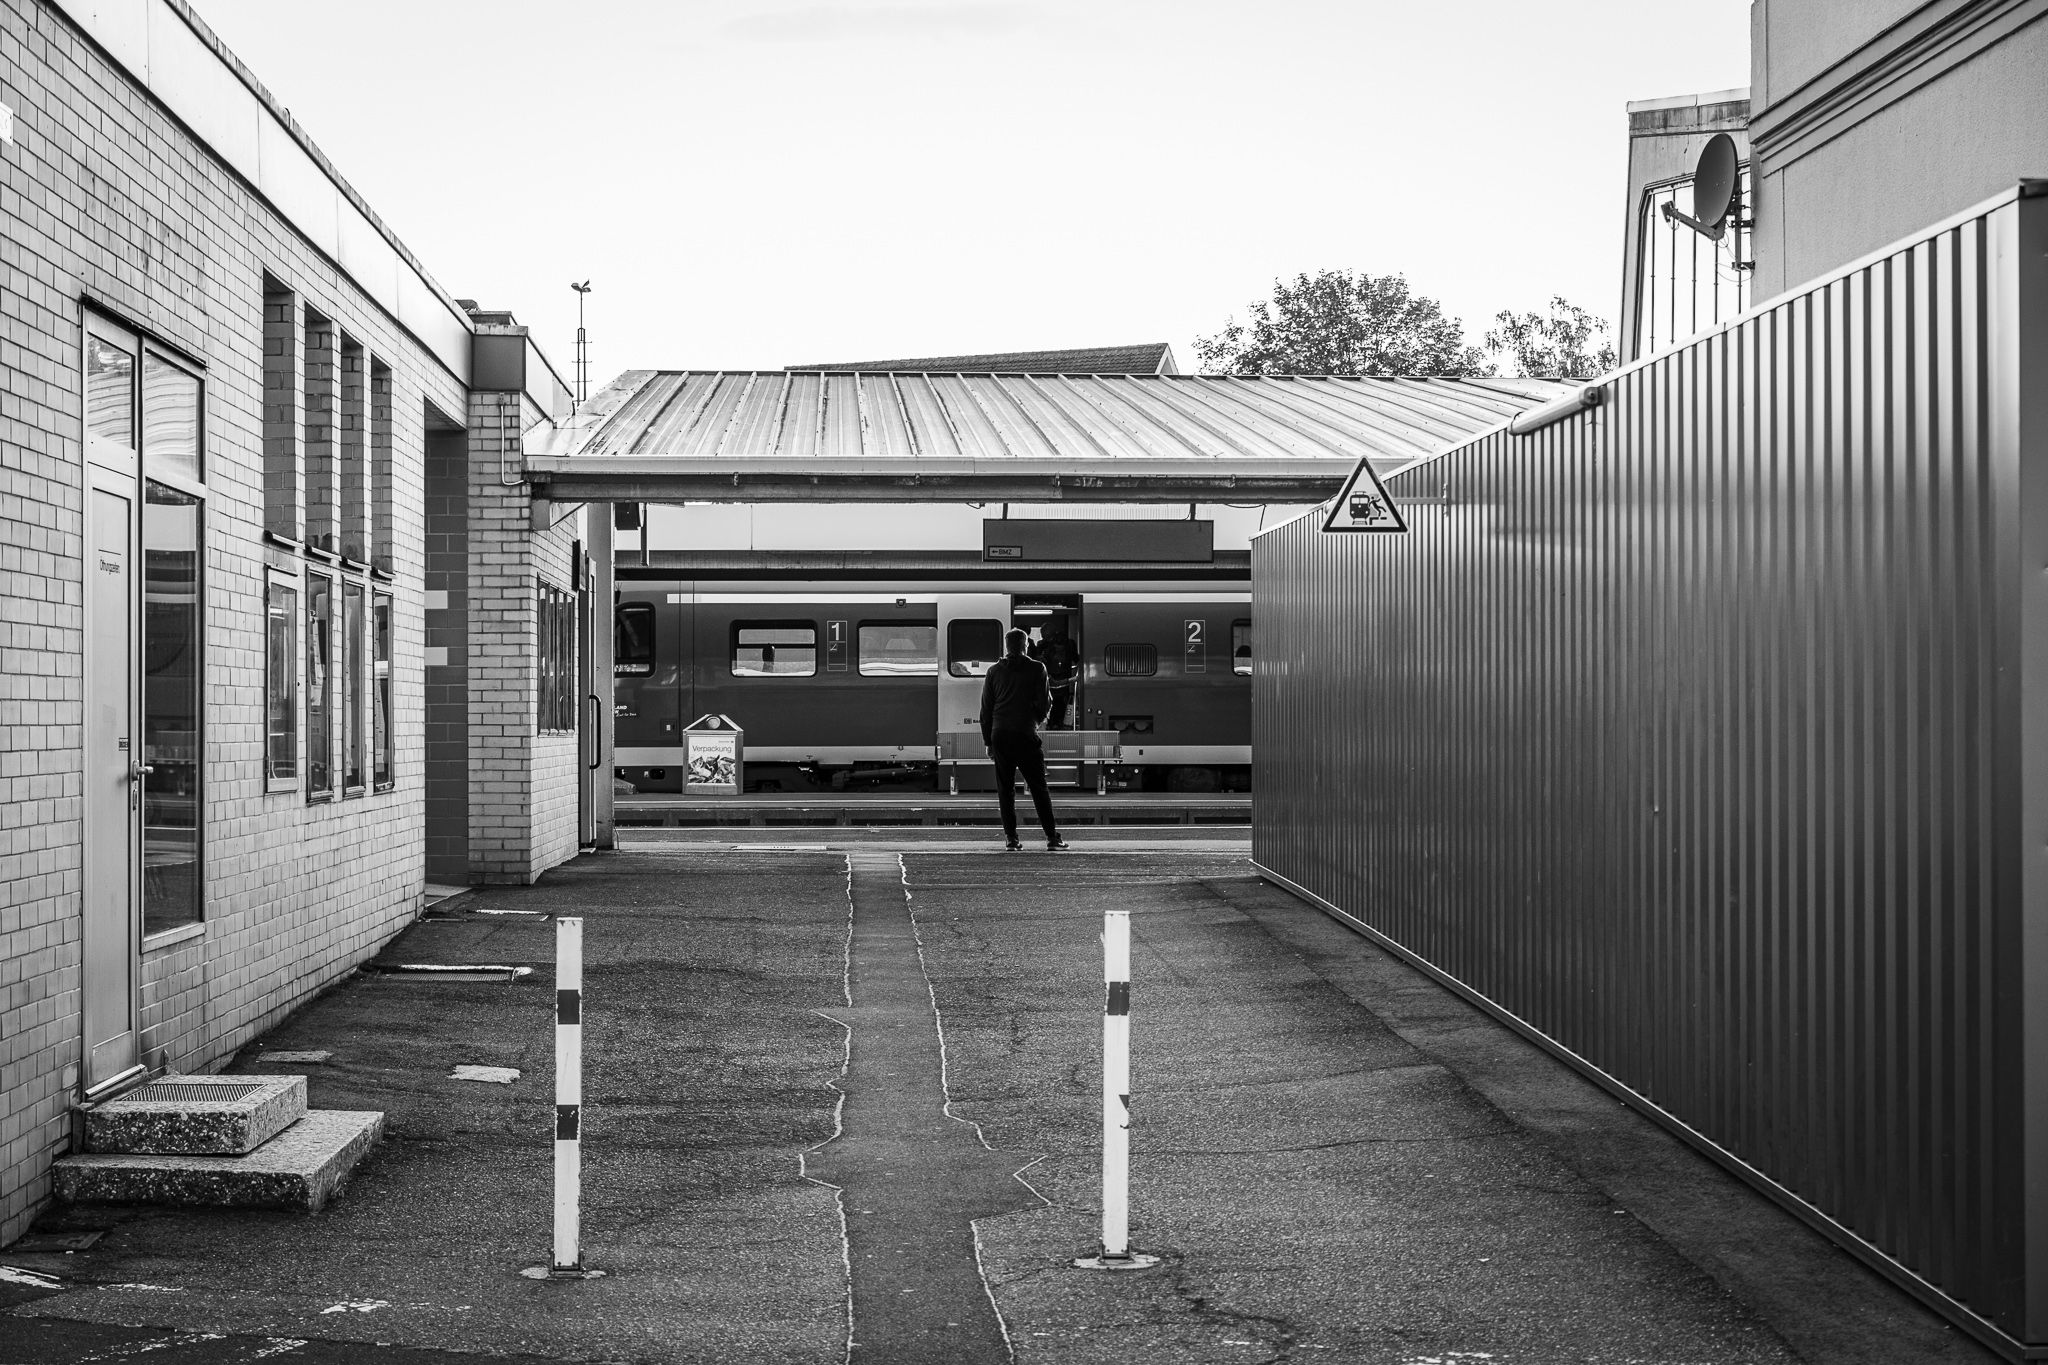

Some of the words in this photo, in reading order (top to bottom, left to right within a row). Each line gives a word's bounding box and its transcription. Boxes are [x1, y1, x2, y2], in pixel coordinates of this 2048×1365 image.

[831, 622, 840, 641] 1
[1188, 621, 1202, 643] 2
[691, 745, 732, 753] Verpackung
